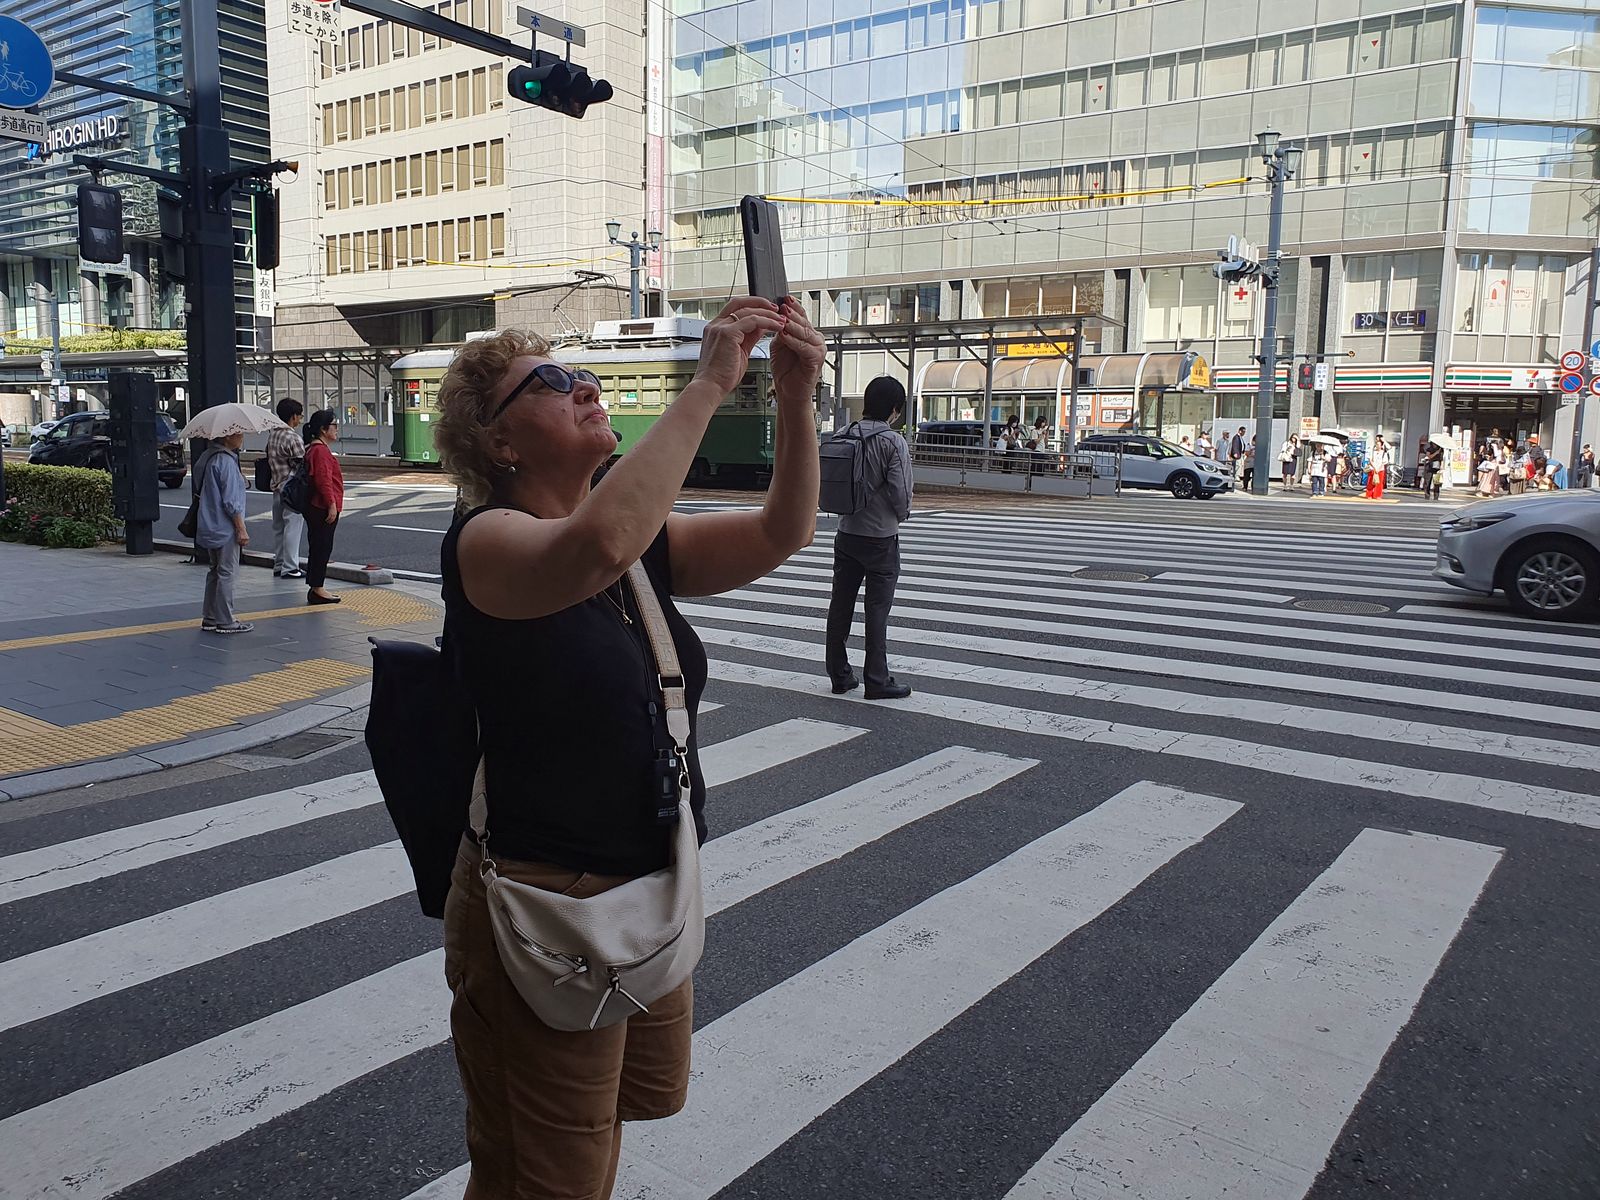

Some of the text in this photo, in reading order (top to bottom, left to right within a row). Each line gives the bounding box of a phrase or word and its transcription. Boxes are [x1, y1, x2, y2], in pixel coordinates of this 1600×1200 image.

[291, 2, 339, 27] 歩道を除く
[292, 19, 338, 42] ここから
[530, 14, 573, 41] 本通
[1, 114, 44, 136] 歩道通行可
[44, 115, 118, 153] HIROGIN HD
[1565, 356, 1580, 366] 20
